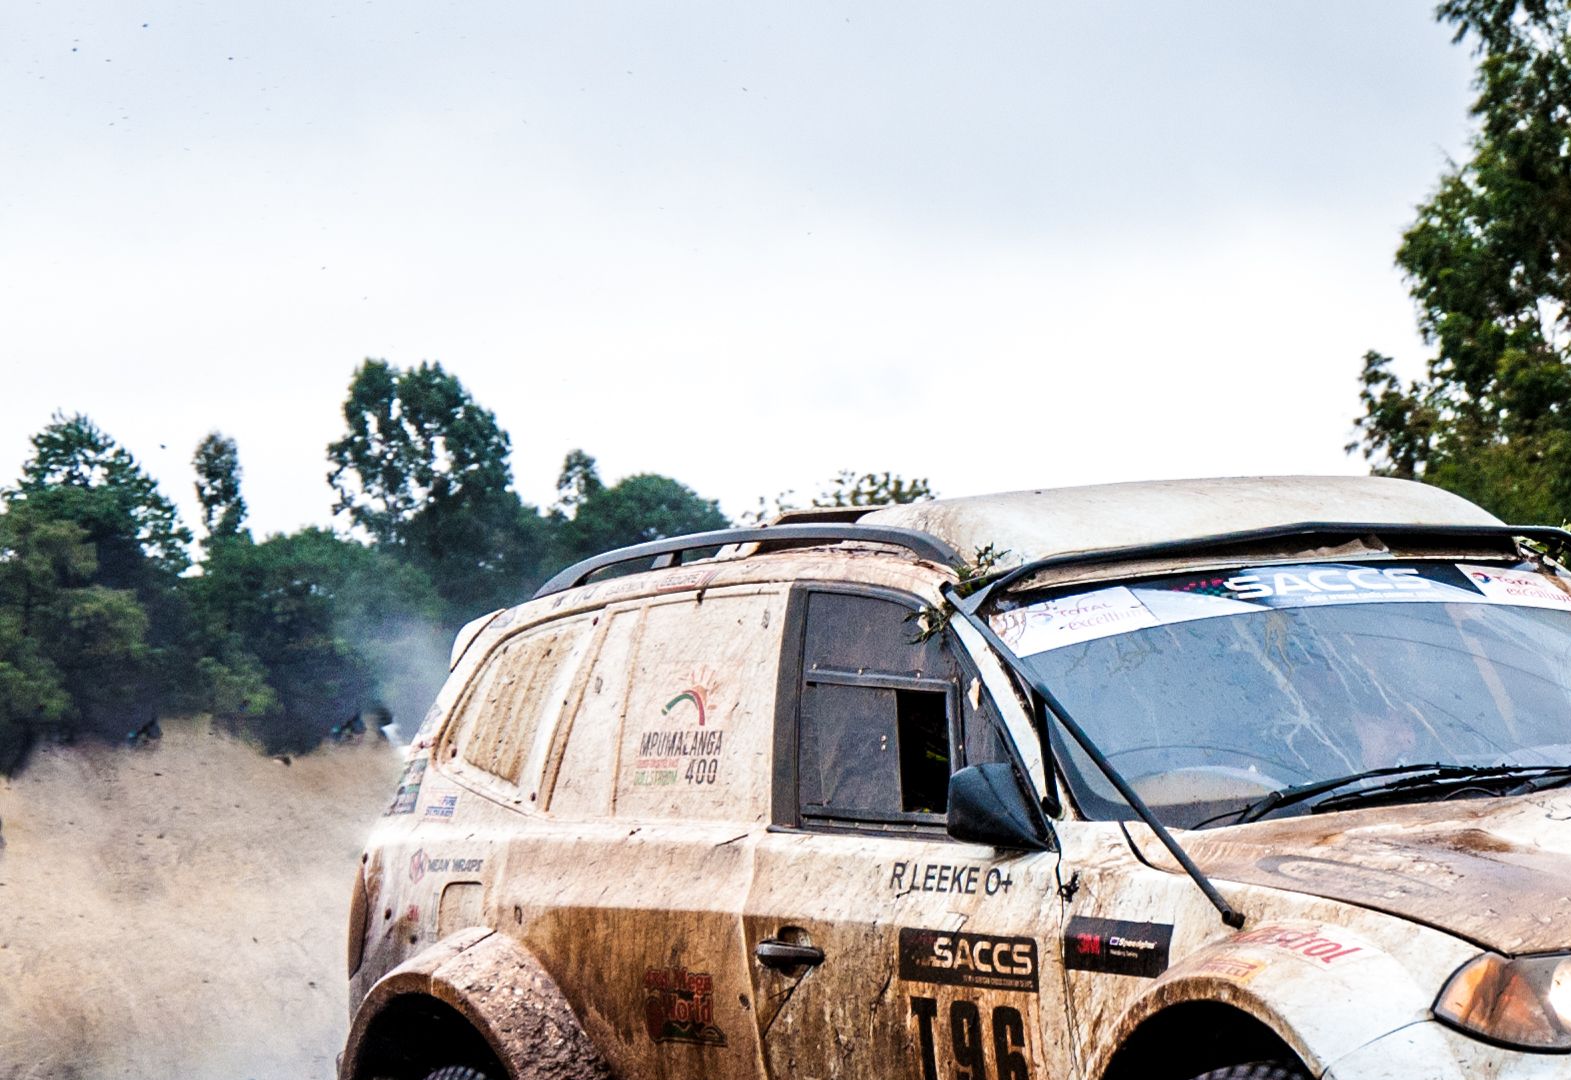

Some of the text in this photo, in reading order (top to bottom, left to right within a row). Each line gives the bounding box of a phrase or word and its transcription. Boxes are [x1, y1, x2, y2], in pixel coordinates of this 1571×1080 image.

[1224, 569, 1431, 600] SACCS
[1056, 602, 1113, 616] TOTAL
[639, 731, 723, 757] MPUMALANGA
[684, 758, 719, 785] 400
[889, 862, 1014, 896] R LEEKE O+
[932, 936, 1033, 976] SACCS
